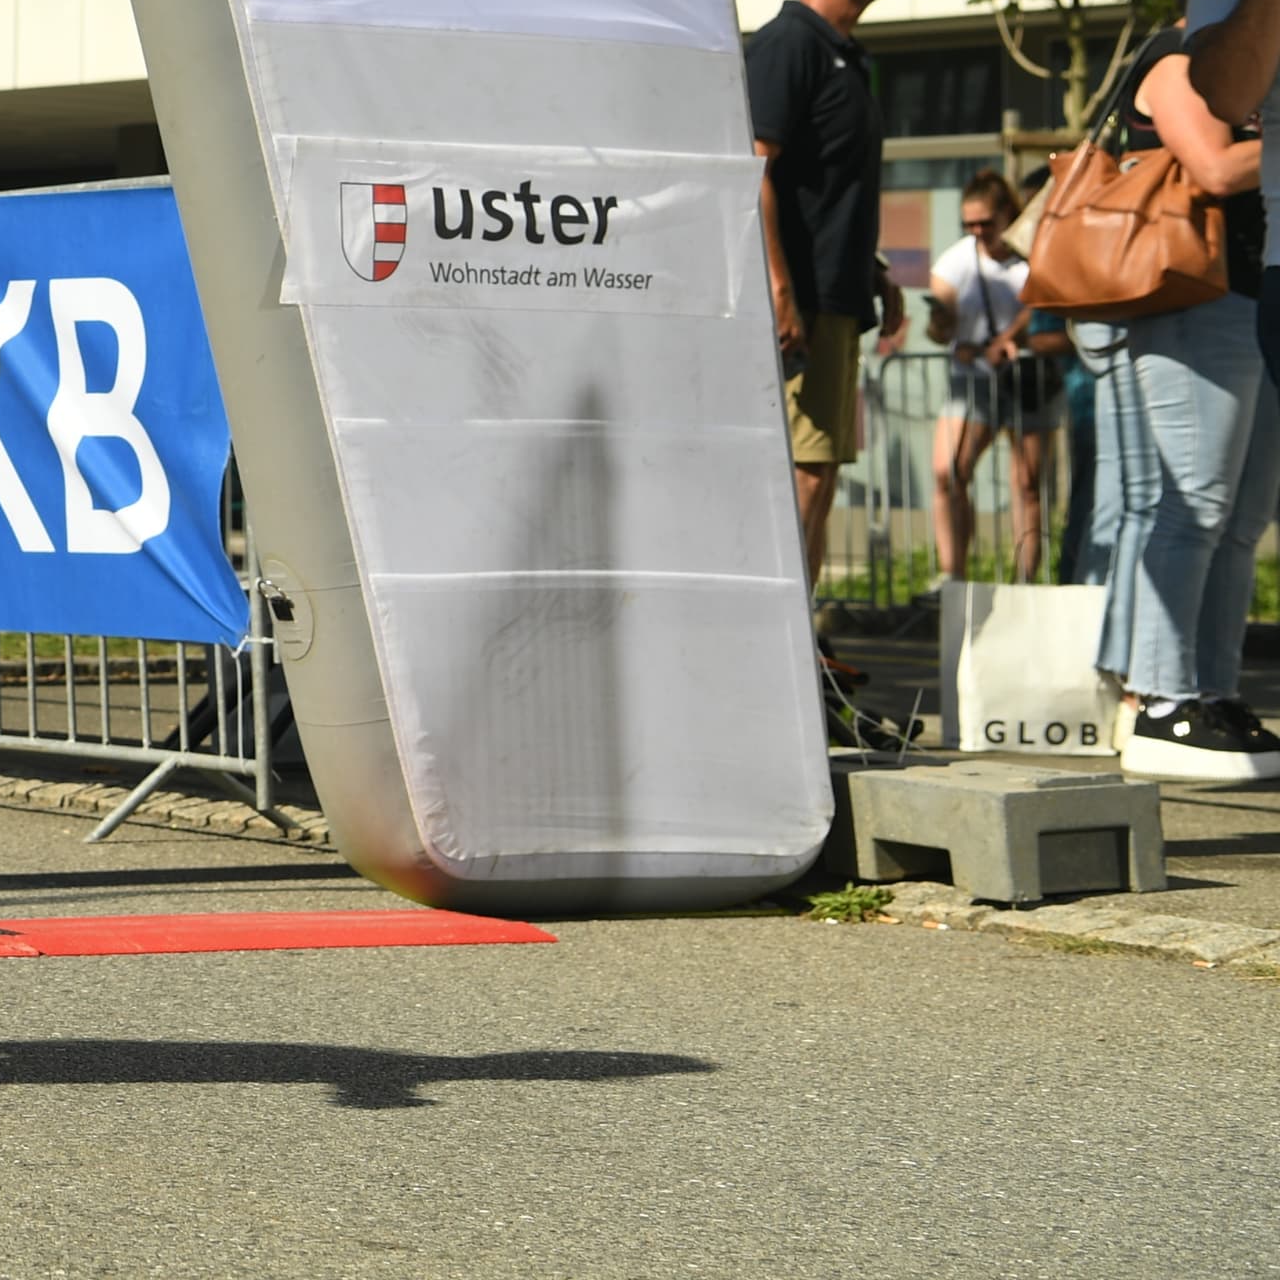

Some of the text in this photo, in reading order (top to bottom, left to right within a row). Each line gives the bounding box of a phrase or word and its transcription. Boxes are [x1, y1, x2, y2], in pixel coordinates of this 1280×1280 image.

[432, 180, 618, 245] uster
[429, 261, 653, 290] Wohnstadt am Wasser
[985, 721, 1098, 746] GLOB
